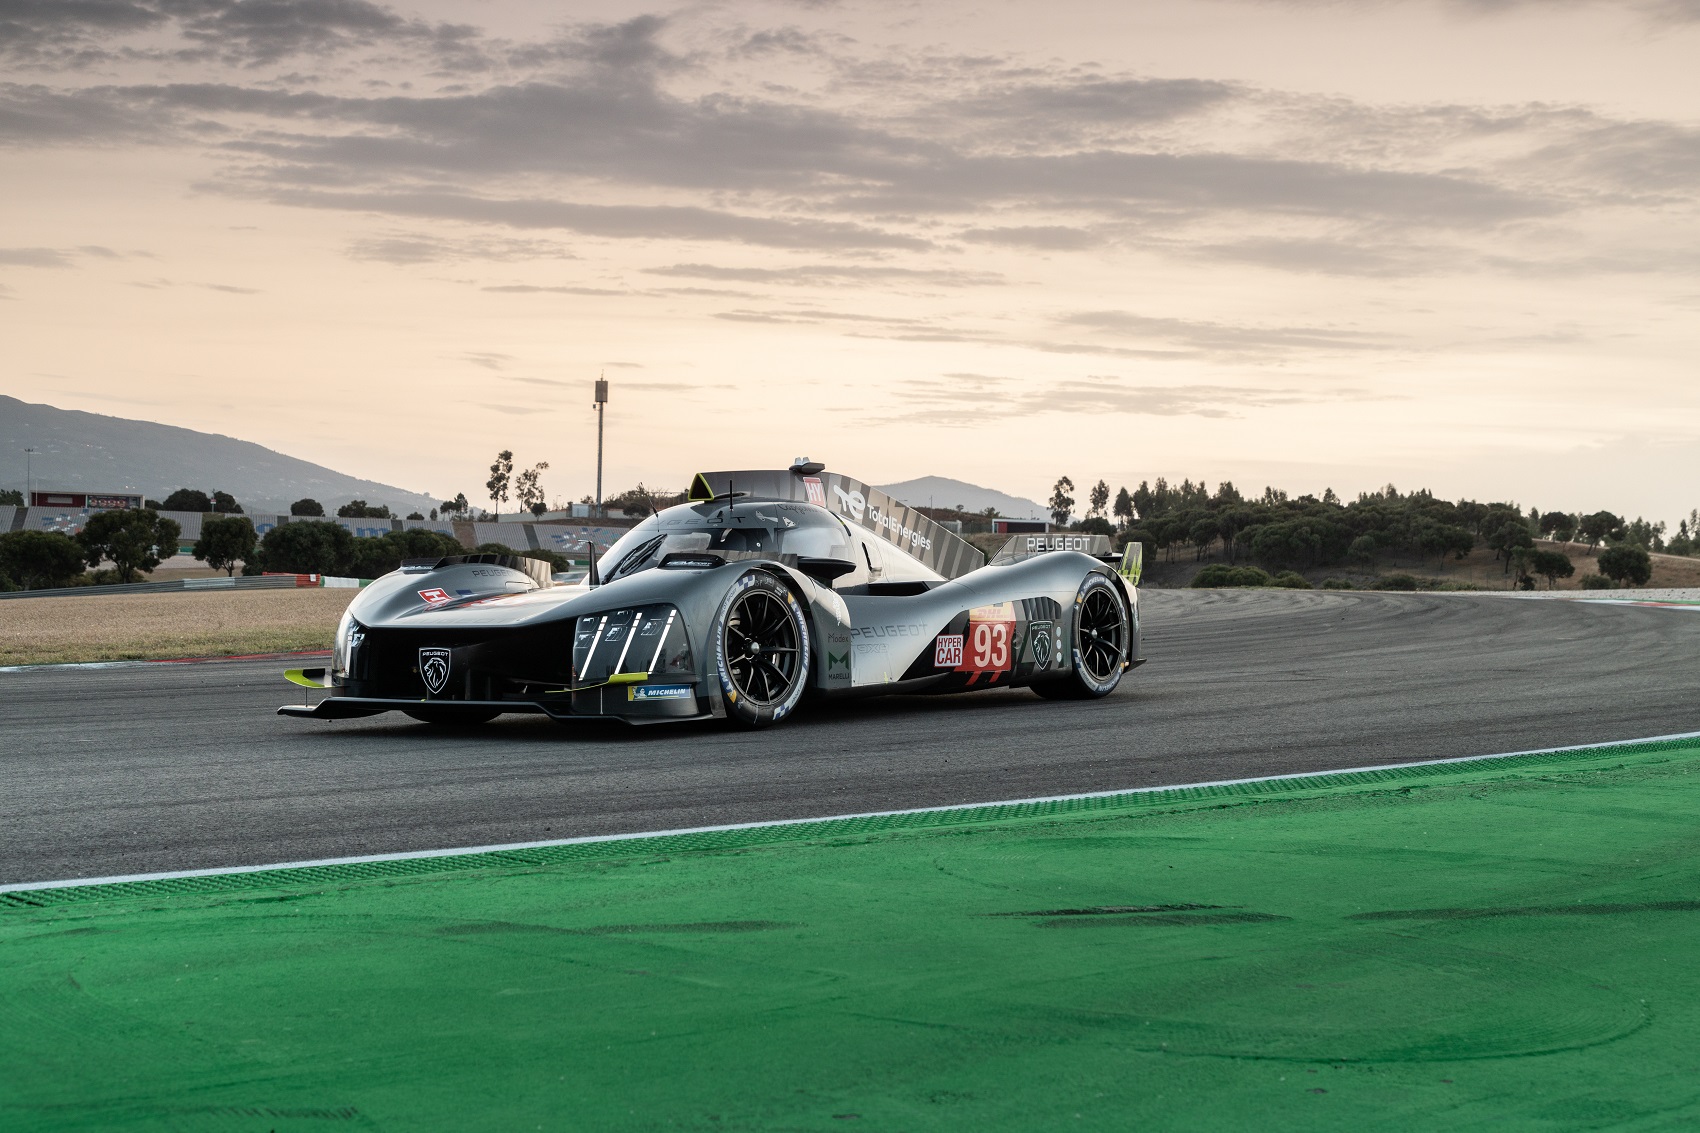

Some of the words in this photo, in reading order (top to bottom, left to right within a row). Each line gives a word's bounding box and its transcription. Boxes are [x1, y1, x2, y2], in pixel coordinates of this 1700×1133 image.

[867, 504, 931, 551] TotalEnergies
[1027, 537, 1090, 551] PEUGEOT
[796, 610, 809, 666] MICHELIN
[851, 624, 928, 639] PEUGEOT
[938, 637, 962, 648] HYPER
[974, 623, 1007, 668] 93
[716, 625, 730, 683] MICHELIN
[937, 648, 961, 664] CAR
[828, 672, 850, 680] MARELLI
[648, 688, 686, 696] MICHELIN
